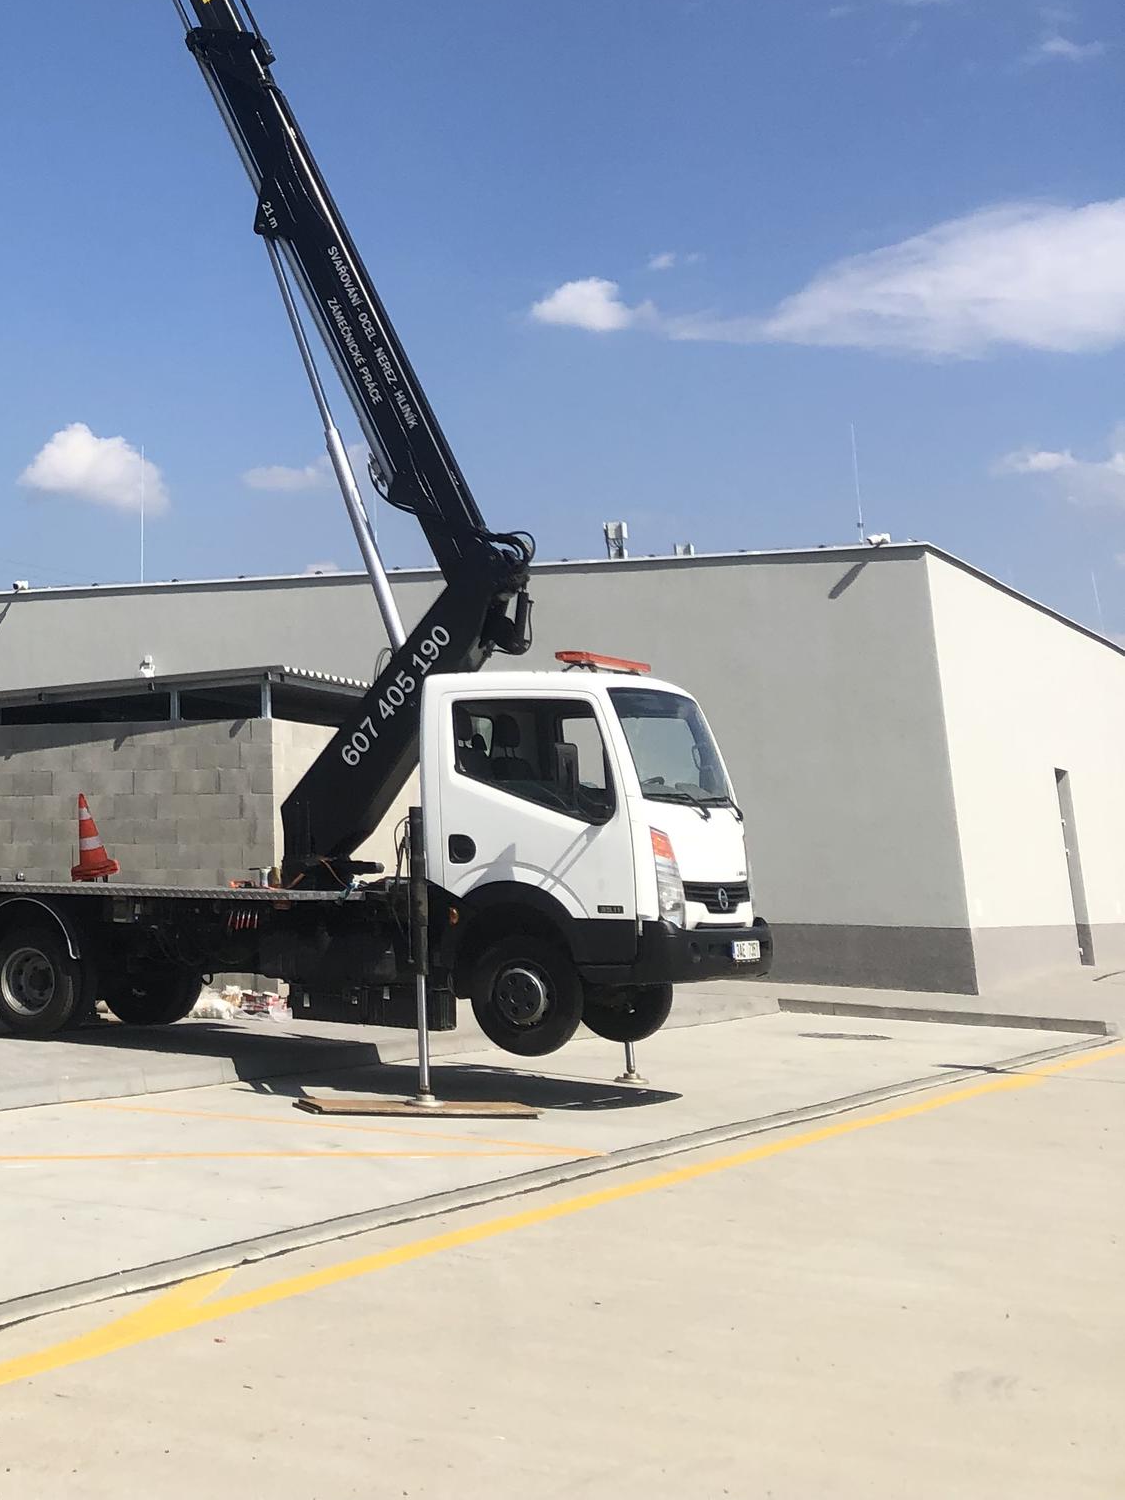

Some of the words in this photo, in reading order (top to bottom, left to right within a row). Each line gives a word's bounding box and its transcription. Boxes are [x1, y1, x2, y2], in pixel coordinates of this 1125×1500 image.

[262, 201, 274, 218] 21
[269, 217, 278, 229] m
[327, 245, 363, 307] SVAŘOVÁNÍ
[358, 312, 377, 342] OCEL
[374, 346, 397, 385] NEREZ
[394, 389, 418, 429] HLINÍK
[327, 297, 367, 367] ZÁMEČNICKÉ
[359, 366, 383, 405] PRÁCE
[341, 716, 379, 766] 607
[378, 670, 416, 720] 405
[412, 625, 451, 675] 190
